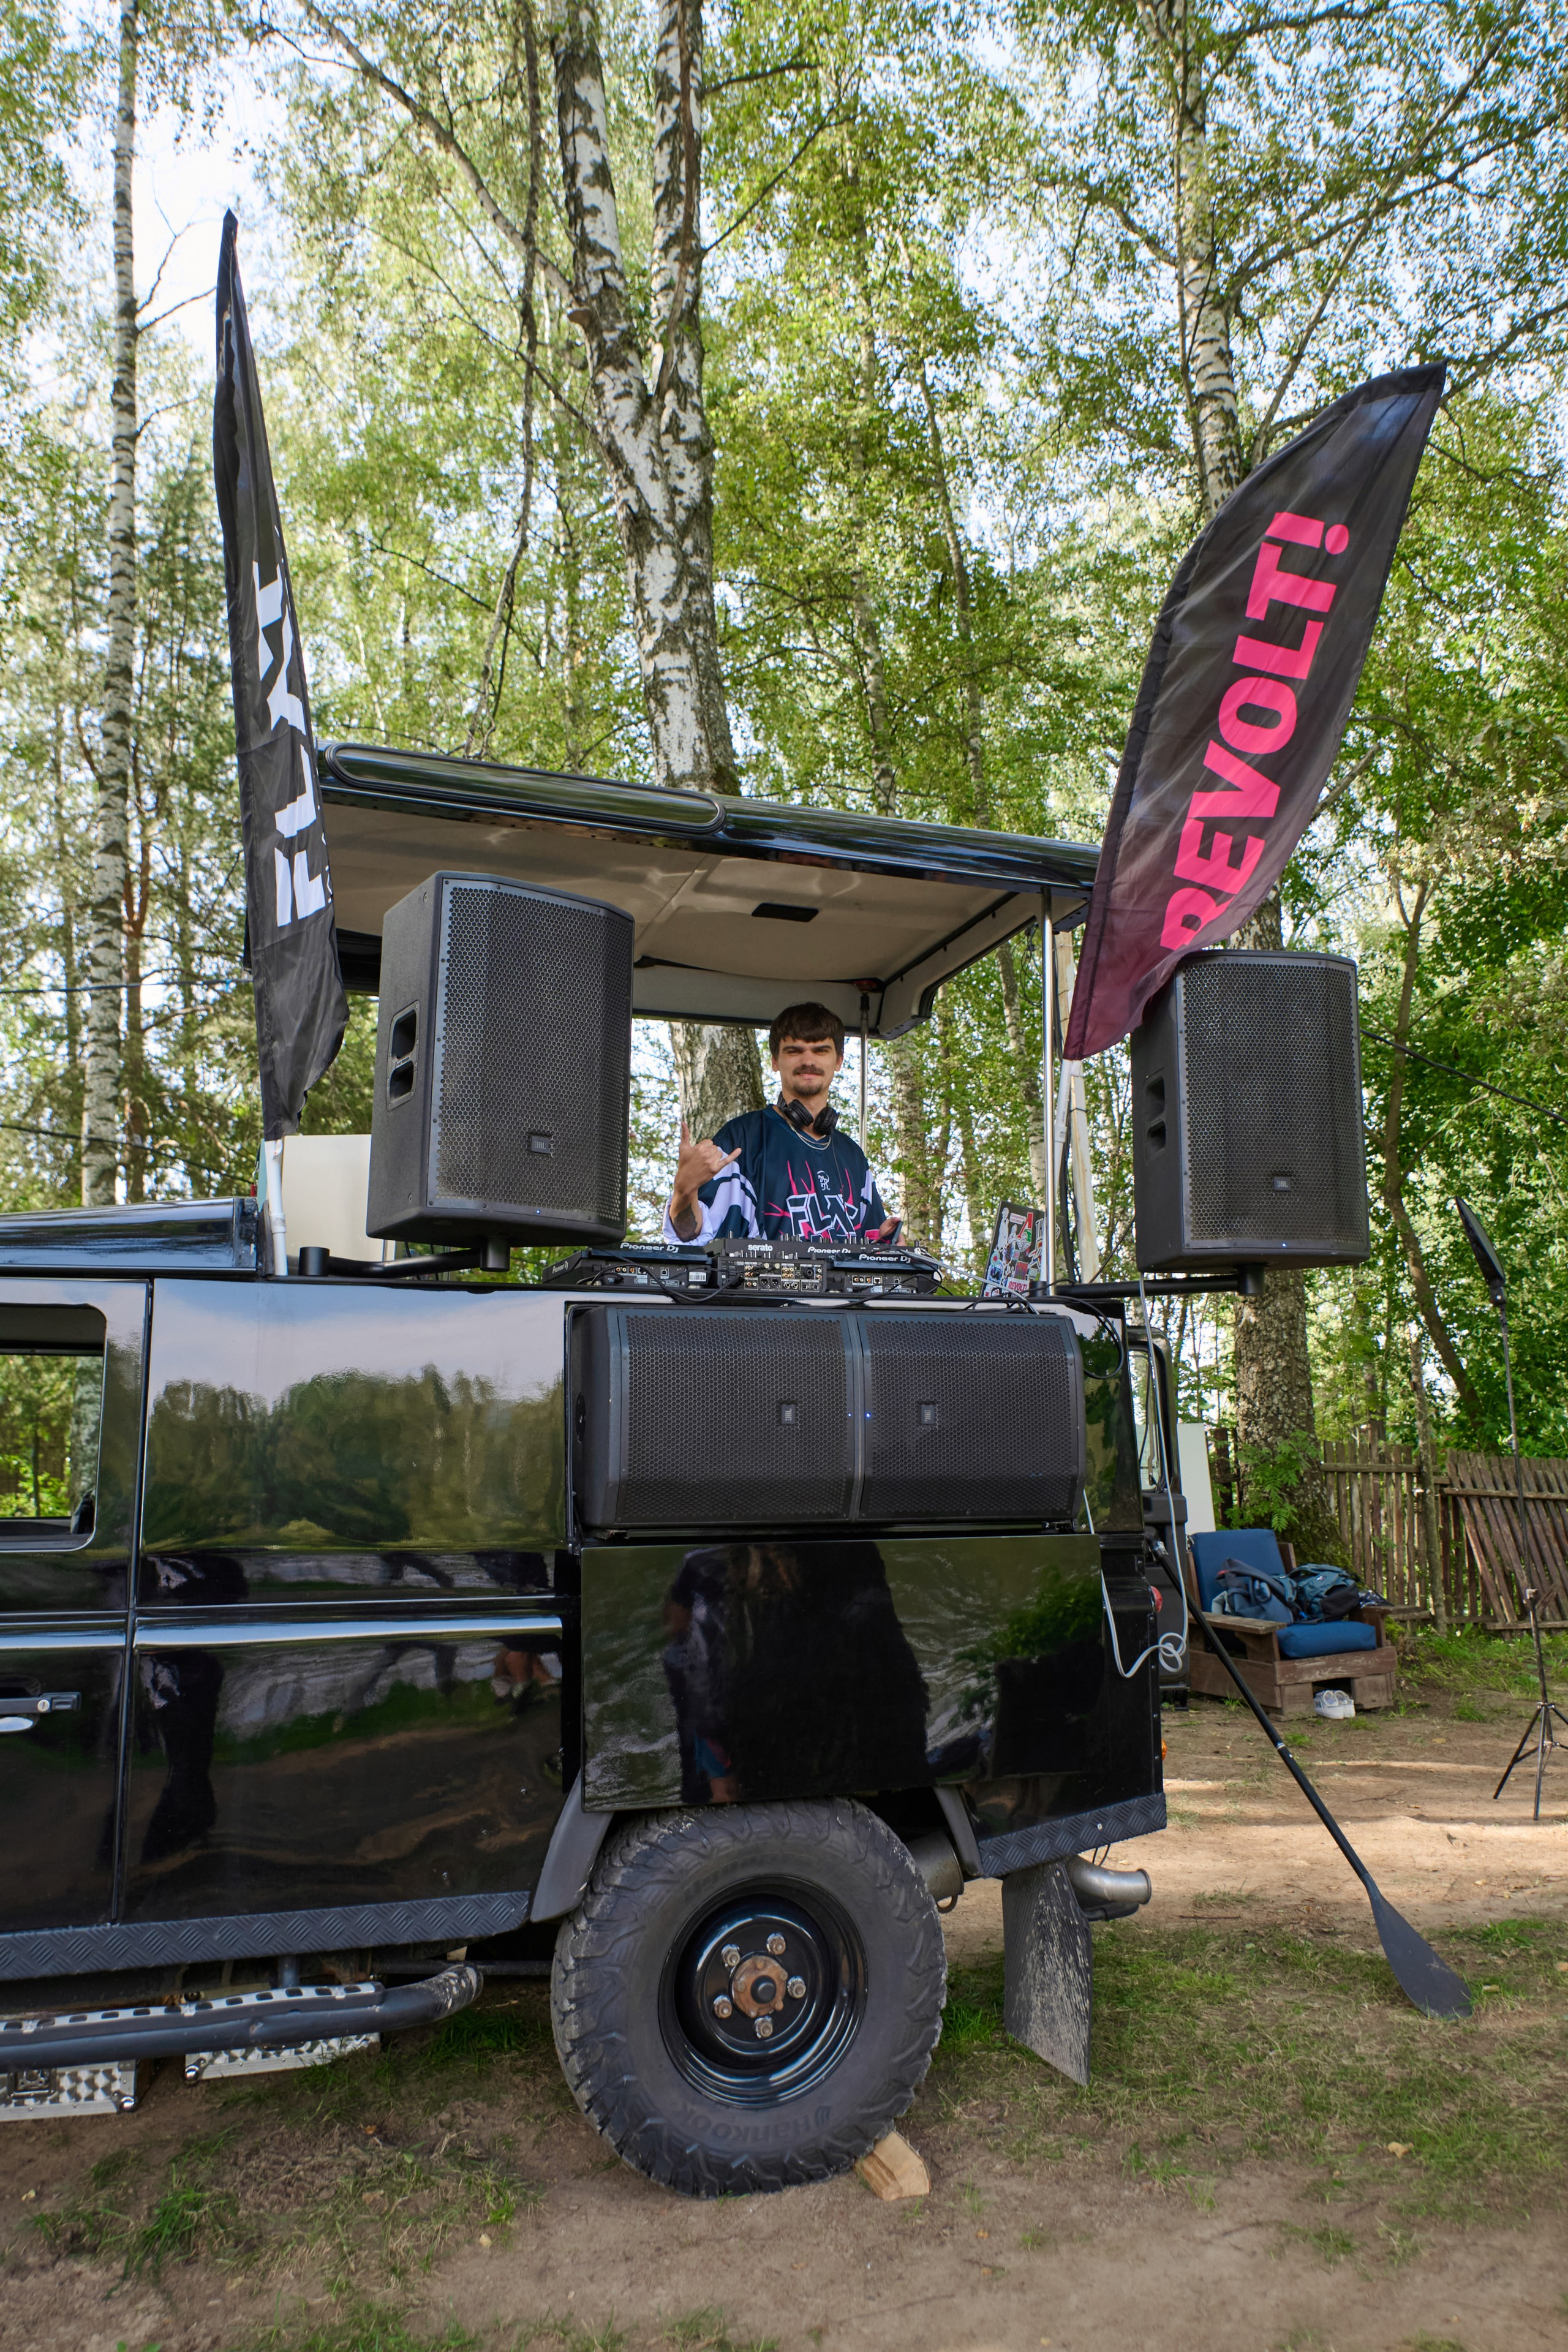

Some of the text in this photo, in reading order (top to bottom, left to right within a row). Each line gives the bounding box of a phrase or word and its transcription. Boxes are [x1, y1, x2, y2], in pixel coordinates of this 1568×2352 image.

[1159, 511, 1349, 951] REVOLT!
[534, 1140, 546, 1150] JBL
[620, 1242, 665, 1251] Pioneer
[747, 1243, 774, 1252] serato
[858, 1253, 899, 1262] Pioneer
